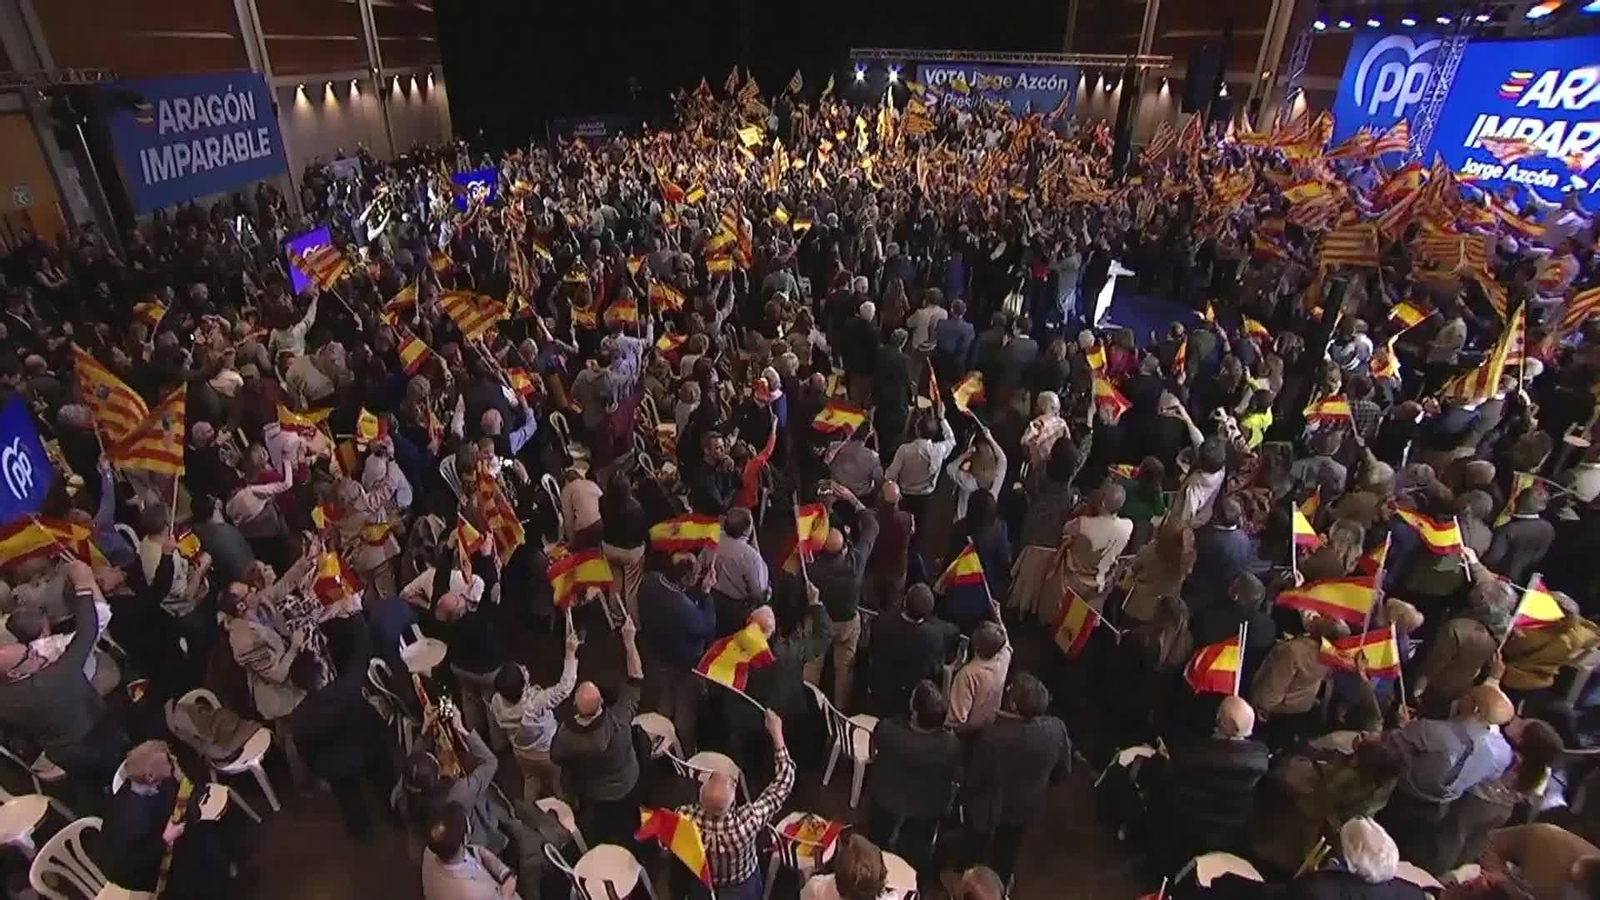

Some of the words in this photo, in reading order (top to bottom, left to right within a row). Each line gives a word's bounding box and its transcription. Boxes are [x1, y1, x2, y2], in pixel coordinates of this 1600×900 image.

[925, 68, 967, 86] VOTA
[969, 70, 1012, 90] Jge
[1015, 72, 1068, 91] Azcón
[158, 83, 257, 135] ARAGÓN
[140, 127, 272, 185] IMPARABLE
[1461, 157, 1504, 180] Jorge
[1503, 164, 1559, 187] Azcón
